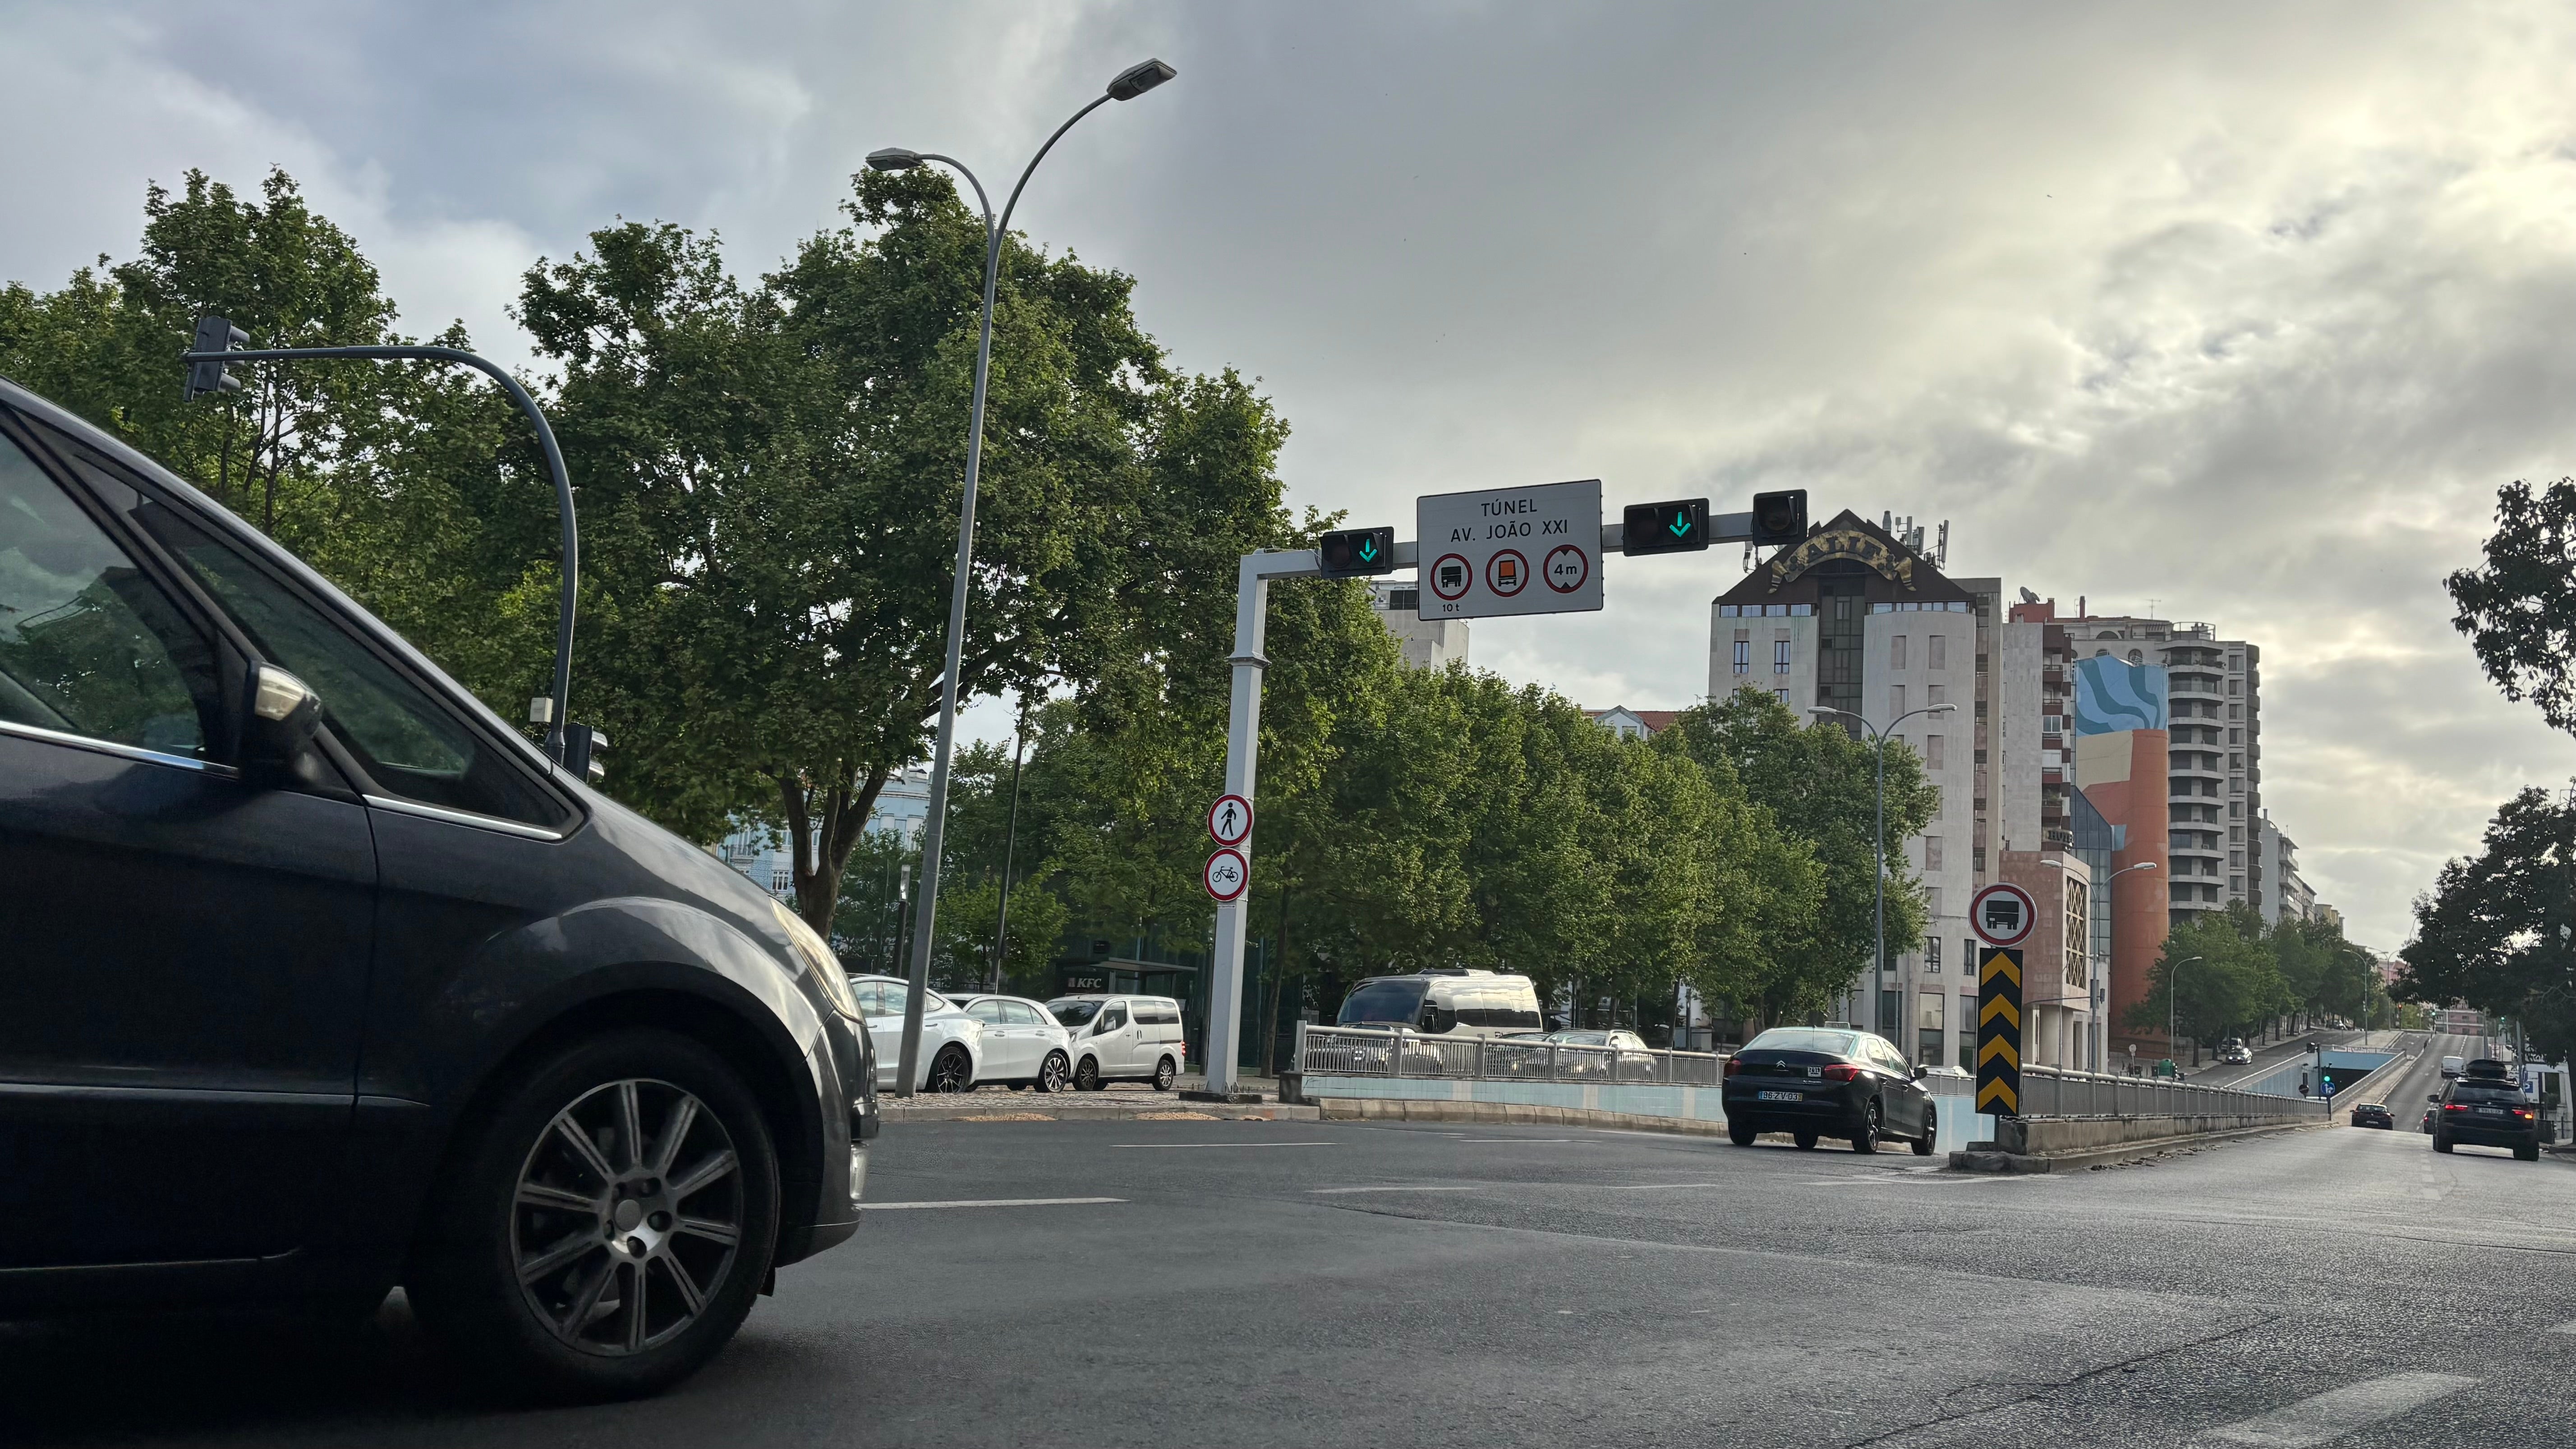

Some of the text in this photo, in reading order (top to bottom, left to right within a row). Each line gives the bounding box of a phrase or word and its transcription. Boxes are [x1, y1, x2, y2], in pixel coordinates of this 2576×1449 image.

[1481, 498, 1537, 517] TÚNEL
[1450, 519, 1567, 543] AV. JOÃO XXI
[1443, 603, 1459, 612] 10 t
[1076, 978, 1102, 988] KFC
